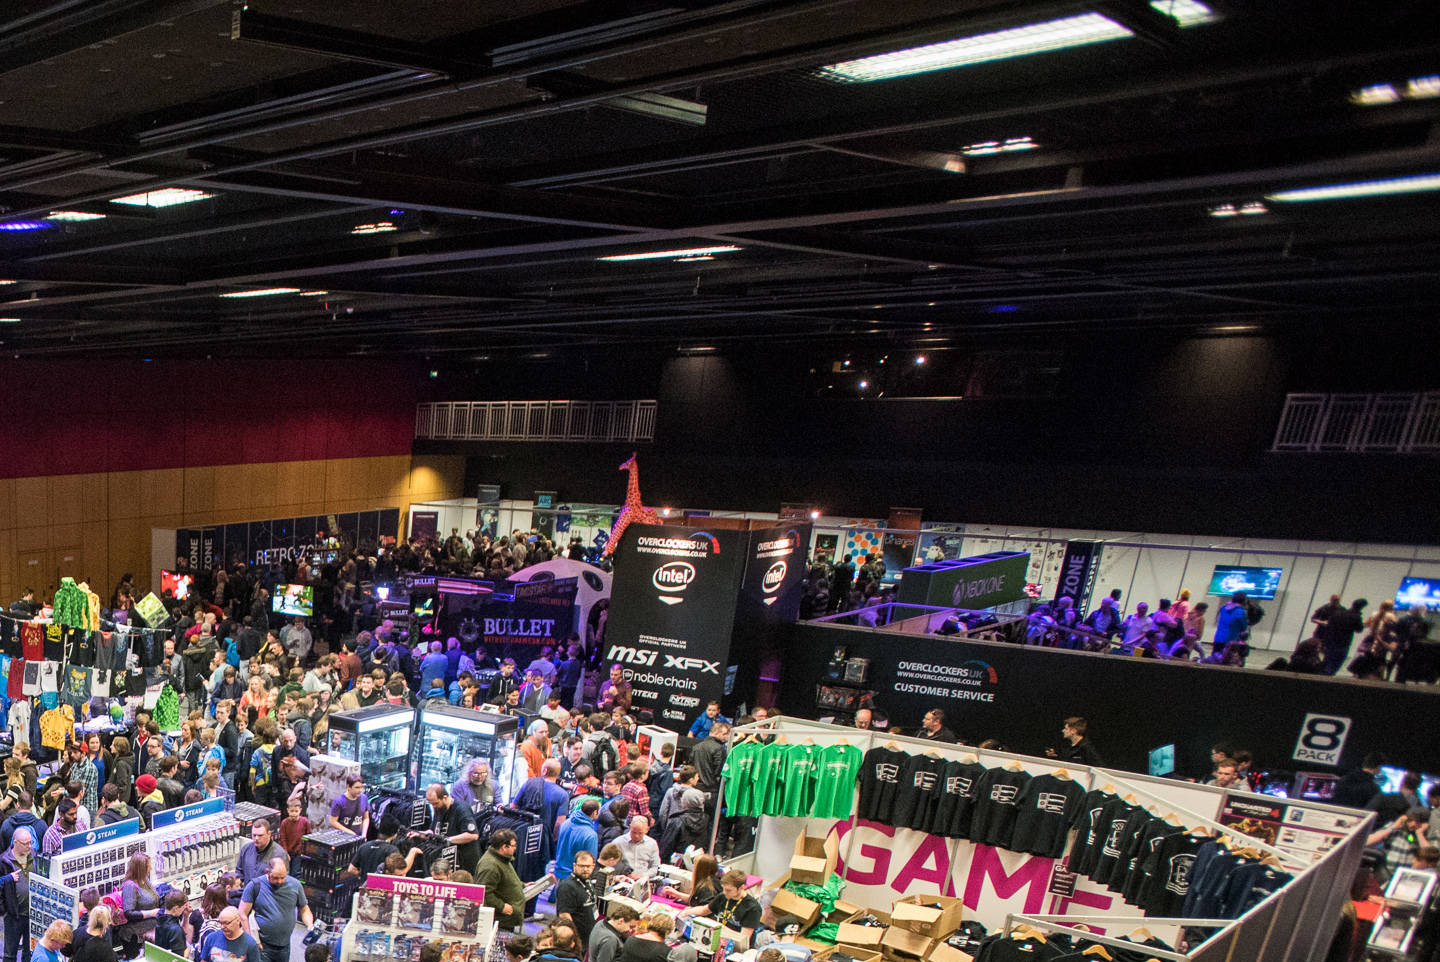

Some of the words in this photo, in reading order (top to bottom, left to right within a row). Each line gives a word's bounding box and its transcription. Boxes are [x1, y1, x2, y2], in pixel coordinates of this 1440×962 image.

[638, 536, 696, 550] OVERCLOCKERS
[696, 542, 708, 551] UK
[190, 538, 198, 571] ZONE
[204, 538, 212, 571] ZONE
[414, 577, 436, 586] BULLET
[658, 568, 689, 584] intel
[766, 567, 782, 584] intel
[1064, 553, 1086, 595] ZONE
[484, 618, 556, 637] BULLET
[606, 644, 659, 667] msi
[663, 654, 721, 675] XFX
[896, 670, 982, 686] WWW.OVERCLOCKERS.CO.UK
[898, 660, 969, 677] OVERCLOCKERS
[968, 669, 984, 679] UK
[894, 682, 950, 697] CUSTOMER
[950, 688, 995, 702] SERVICE
[1301, 717, 1347, 751] 8
[1296, 749, 1337, 762] PACK
[185, 807, 204, 817] STEAM
[96, 829, 118, 840] STEAM
[393, 881, 418, 894] TOYS
[418, 884, 435, 896] TO
[435, 886, 458, 899] LIFE
